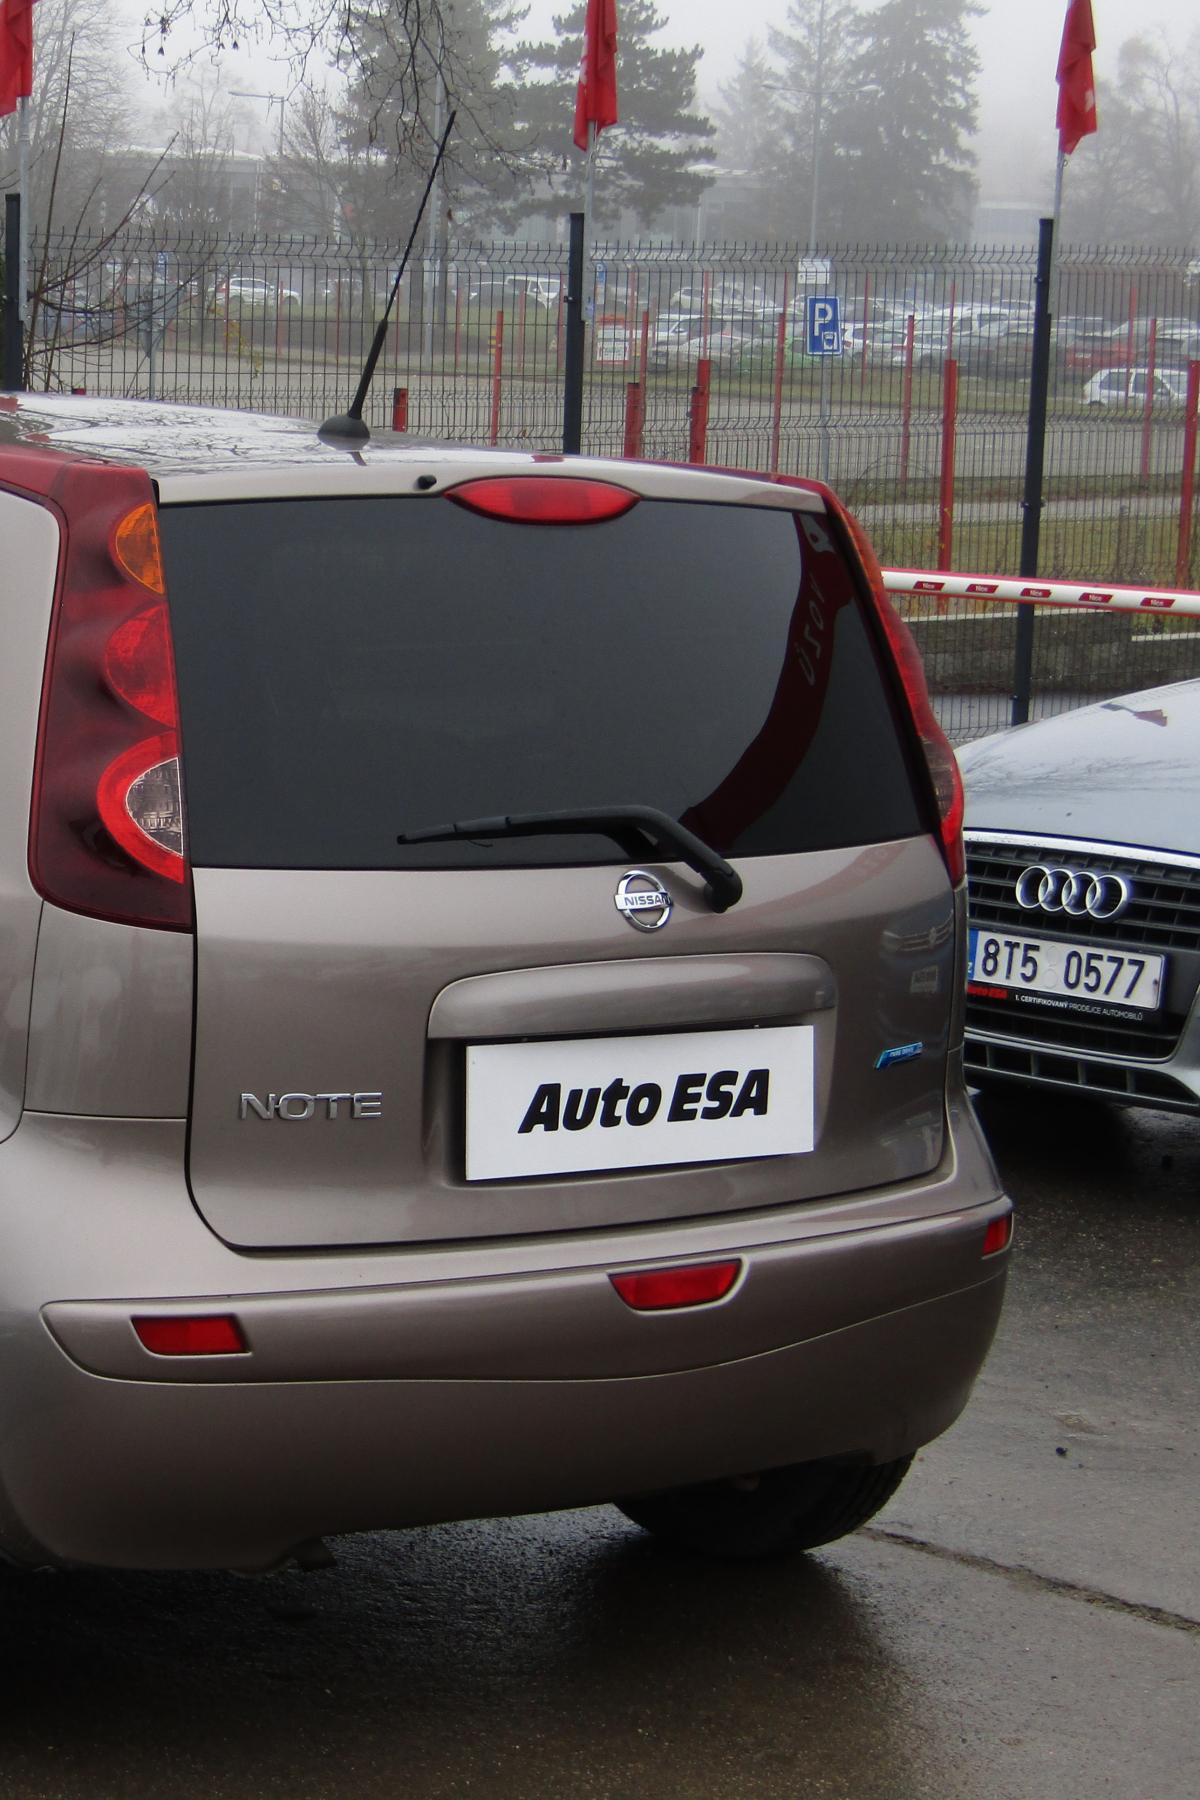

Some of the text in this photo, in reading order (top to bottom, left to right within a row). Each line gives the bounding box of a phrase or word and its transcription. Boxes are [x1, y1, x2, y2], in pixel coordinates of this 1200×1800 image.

[814, 303, 833, 337] P
[624, 894, 672, 907] NISSAN
[981, 938, 1041, 983] 8T5
[1063, 950, 1146, 999] 0577
[240, 1092, 383, 1121] NOTE
[517, 1068, 770, 1134] Auto ESA
